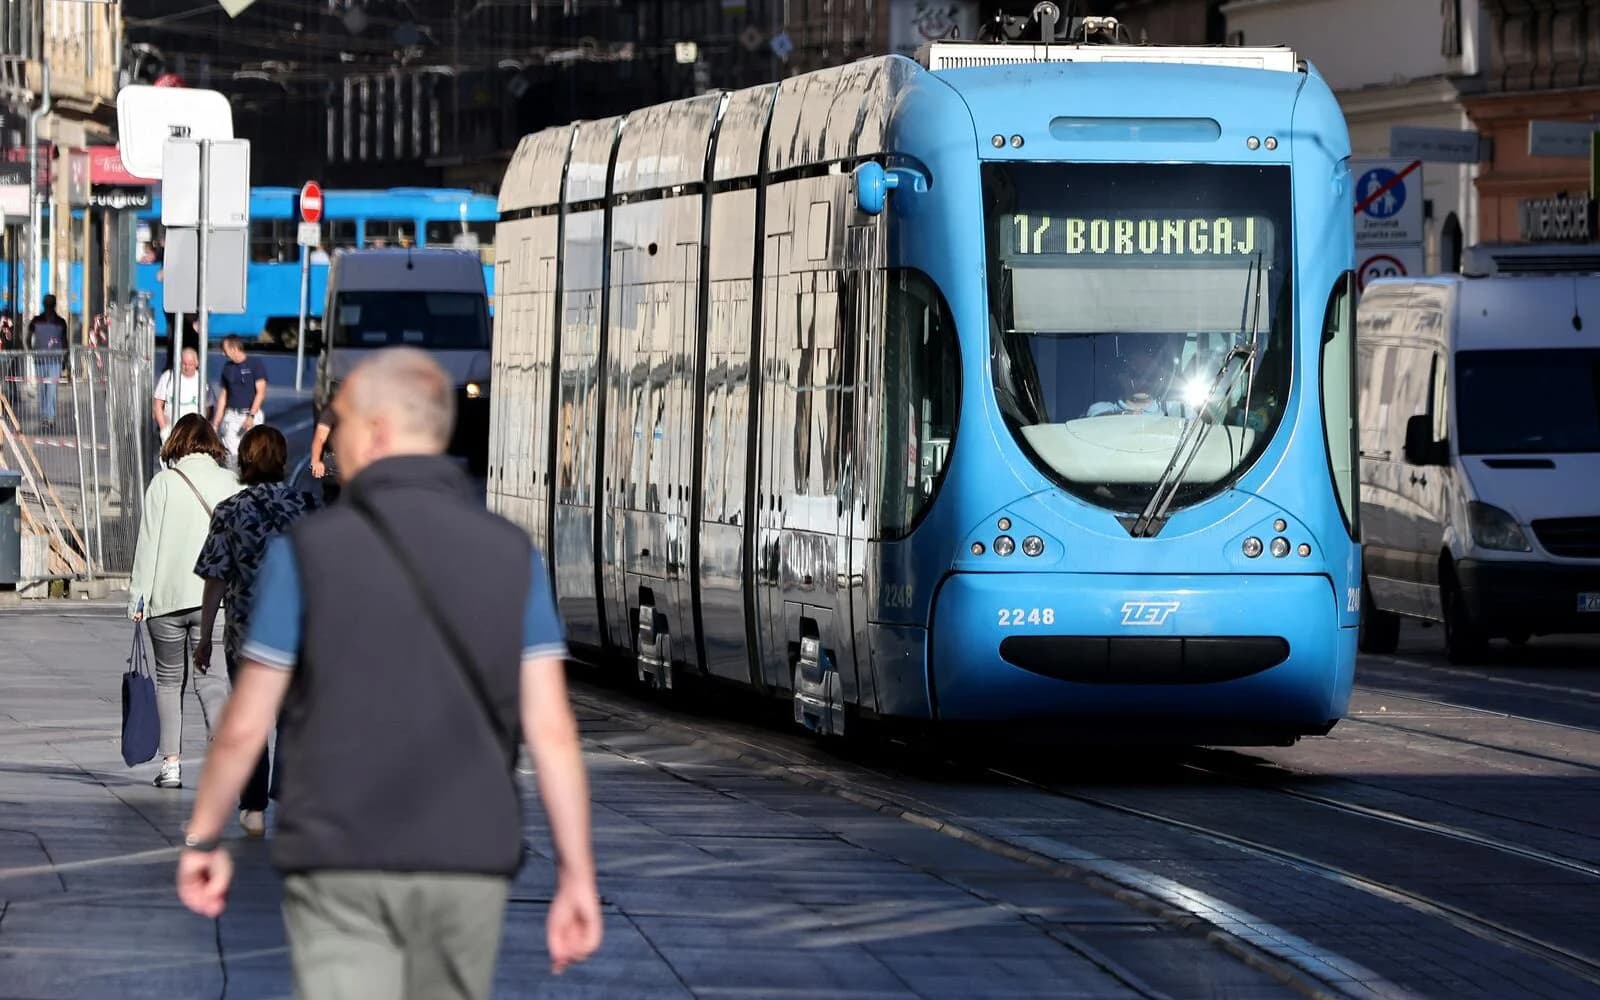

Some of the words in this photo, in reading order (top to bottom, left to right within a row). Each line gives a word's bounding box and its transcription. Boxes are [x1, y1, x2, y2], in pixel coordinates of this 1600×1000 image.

[1014, 215, 1050, 254] 17
[1066, 217, 1254, 255] BORONGAJ
[884, 584, 913, 608] 2248
[998, 608, 1055, 626] 2248
[1121, 602, 1180, 626] ZET
